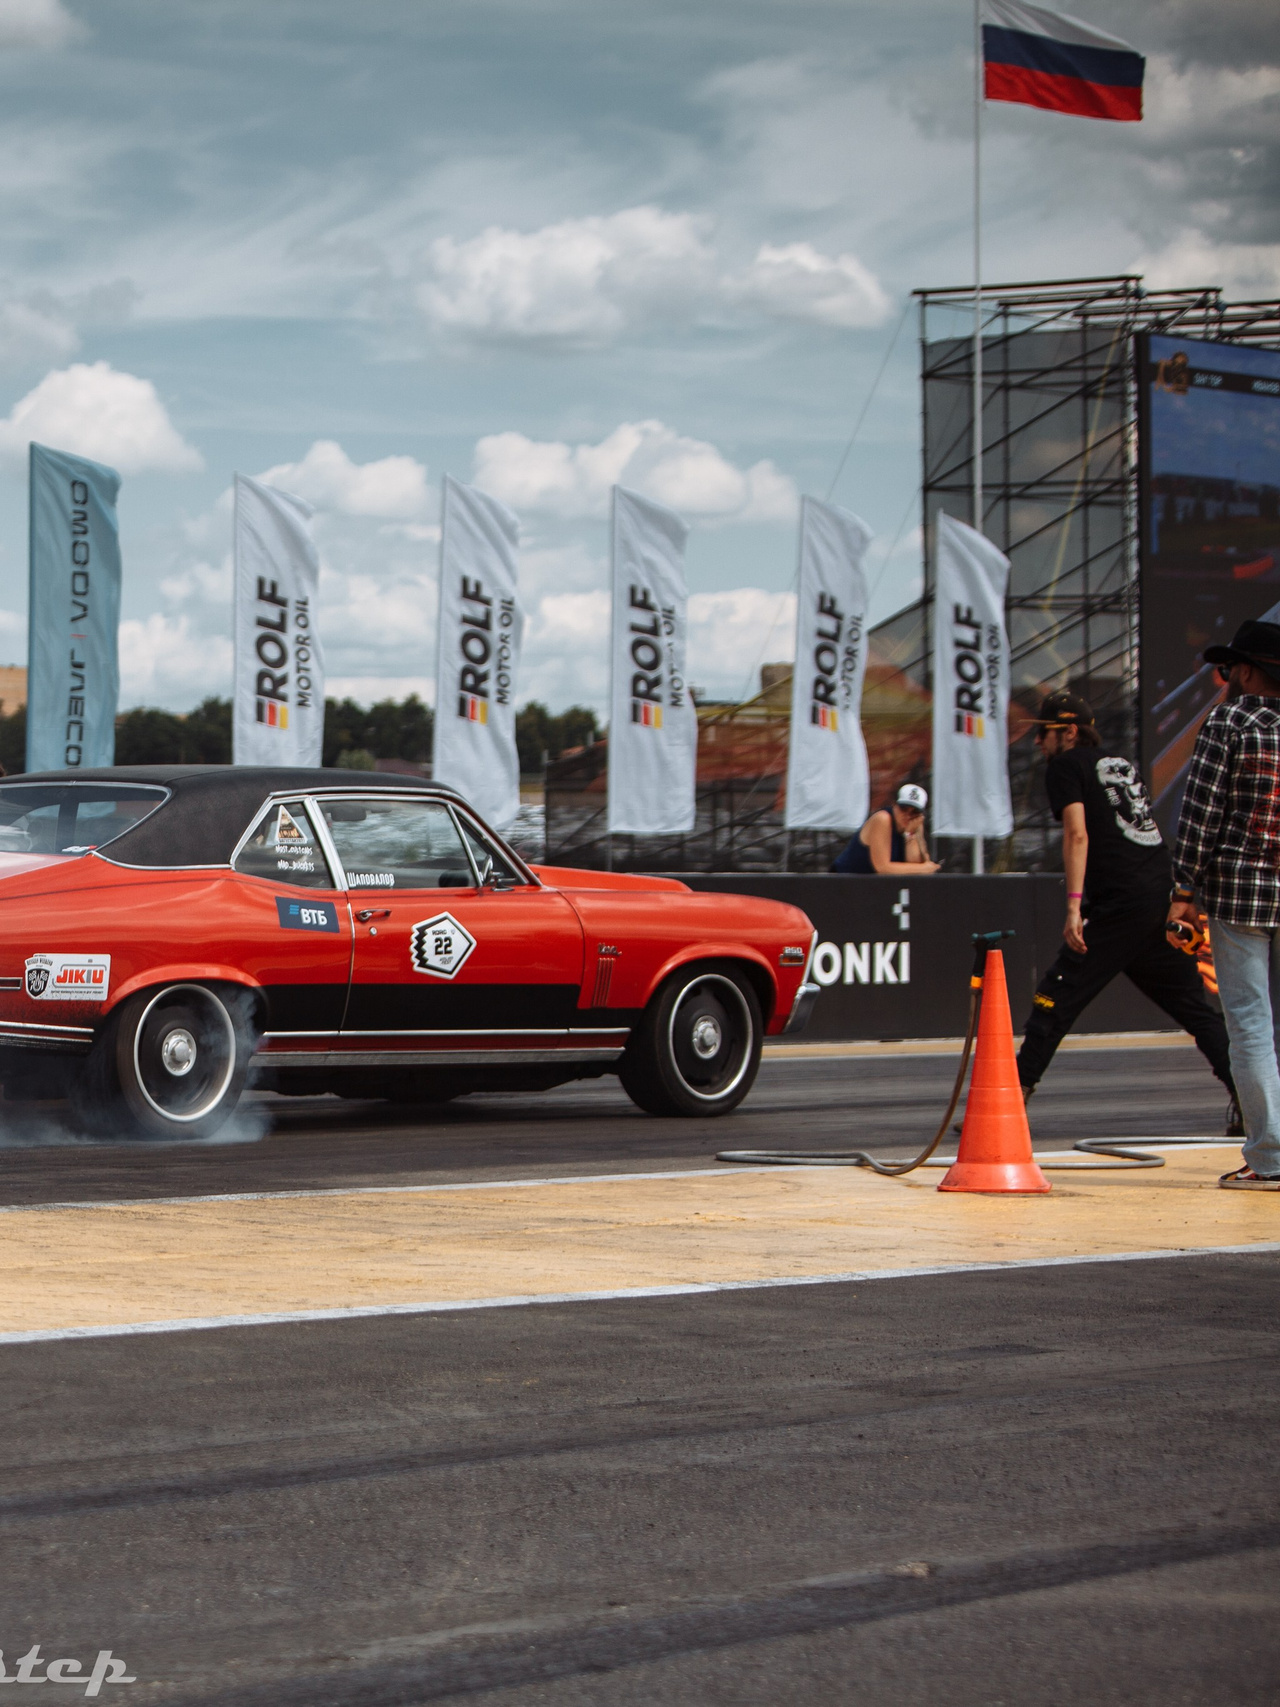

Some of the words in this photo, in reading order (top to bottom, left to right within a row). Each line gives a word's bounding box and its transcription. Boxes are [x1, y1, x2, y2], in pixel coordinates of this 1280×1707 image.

[71, 480, 90, 622] OMODA
[255, 575, 289, 703] ROLF
[295, 597, 309, 629] OIL
[459, 574, 492, 698] ROLF
[498, 597, 515, 629] OIL
[629, 584, 663, 703] ROLF
[662, 605, 674, 636] OIL
[812, 592, 843, 706] ROLF
[295, 634, 312, 708] MOTOR
[496, 634, 512, 705] MOTOR
[954, 603, 983, 714] ROLF
[65, 649, 86, 768] JAECO
[347, 872, 395, 887] ШАПОВАЛОВ
[300, 908, 328, 925] ВТБ
[434, 936, 453, 955] 22
[55, 969, 104, 983] JIKIU
